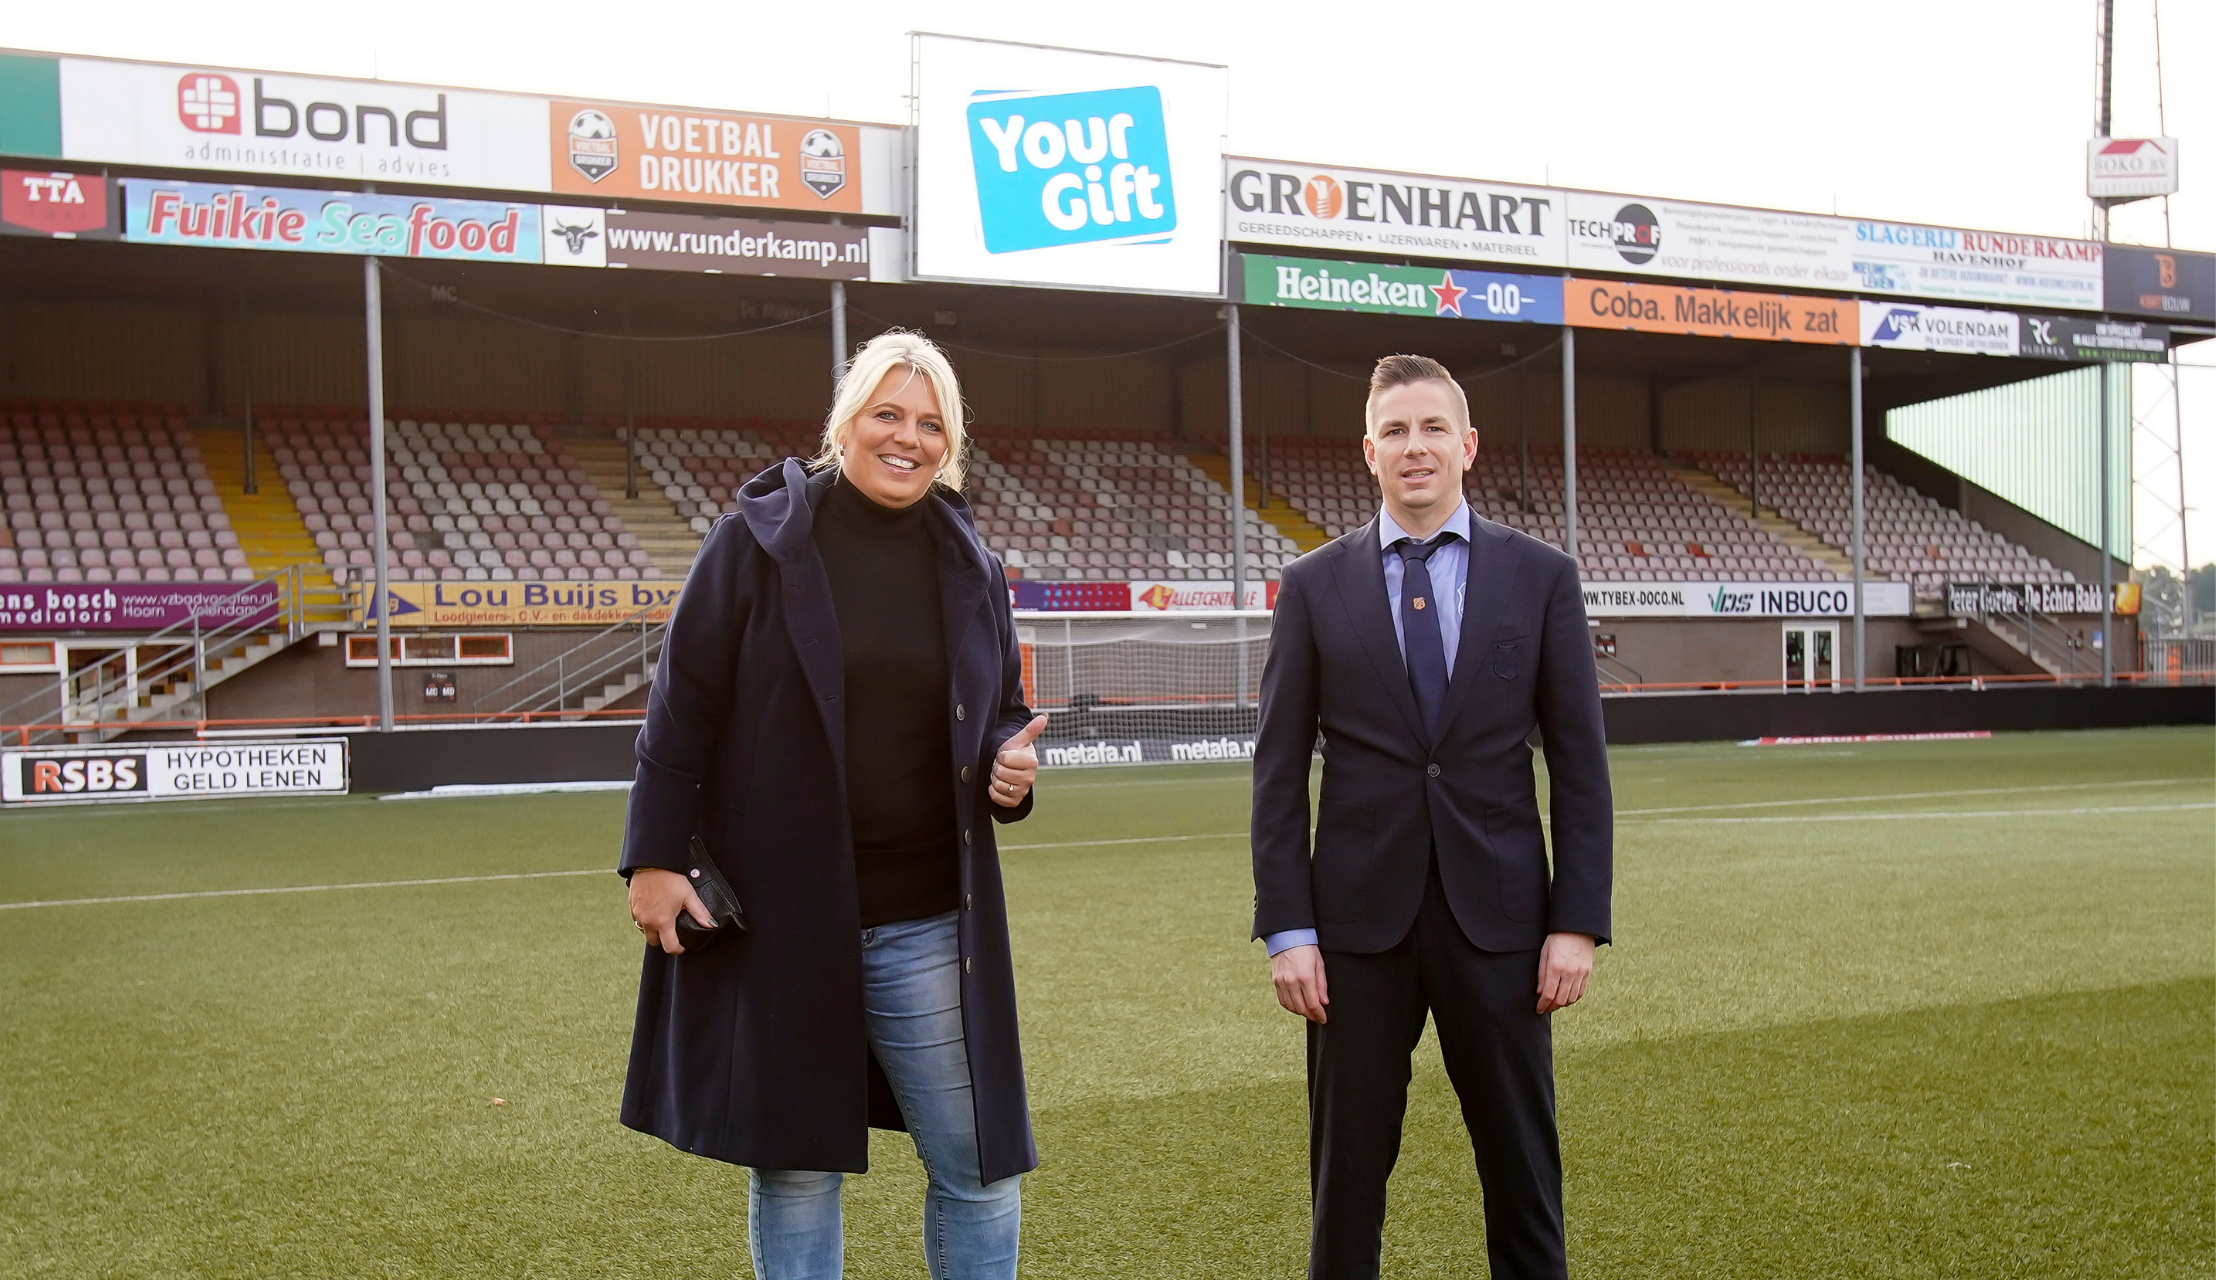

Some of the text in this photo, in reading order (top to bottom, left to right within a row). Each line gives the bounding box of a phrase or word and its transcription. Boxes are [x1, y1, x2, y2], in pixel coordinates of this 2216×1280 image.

[254, 78, 448, 151] bond
[640, 113, 780, 159] VOETBAL
[979, 113, 1134, 172] Your
[185, 142, 451, 177] administratie advies
[23, 177, 85, 204] TTA
[640, 154, 780, 198] DRUKKER
[1041, 162, 1164, 231] Gift
[1230, 169, 1550, 237] GROENHART
[148, 189, 519, 257] Fuikie Seafood
[1568, 218, 1660, 248] TECHPROF
[608, 227, 869, 267] www.runderkamp.nl
[1238, 221, 1364, 243] GEREEDSCHAPPEN
[1471, 242, 1538, 257] MATERIEEL
[1856, 223, 2101, 263] SLAGERIJ RUNDERKAMP
[1661, 255, 1689, 269] voor
[1691, 256, 1770, 275] professionals
[1774, 263, 1809, 279] onder
[1933, 250, 2028, 269] HAVENHOF
[1276, 265, 1428, 309] Heineken
[1486, 282, 1520, 315] 0.0
[1590, 287, 1839, 336] Coba. Makkelijk zat
[1925, 318, 2009, 339] VOLENDAM
[46, 588, 117, 610] bosch
[122, 605, 165, 618] Hoorn
[435, 583, 507, 606] Lou
[524, 583, 617, 610] Buijs
[1760, 590, 1848, 613] INBUCO
[2042, 584, 2075, 613] Echte
[2076, 583, 2115, 613] Bakkr
[552, 611, 567, 621] en
[167, 748, 327, 769] HYPOTHEKEN
[1046, 740, 1143, 766] metafa.nl
[1171, 737, 1256, 761] metafa.n
[33, 758, 138, 794] RSBS
[174, 770, 322, 791] GELD LENEN
